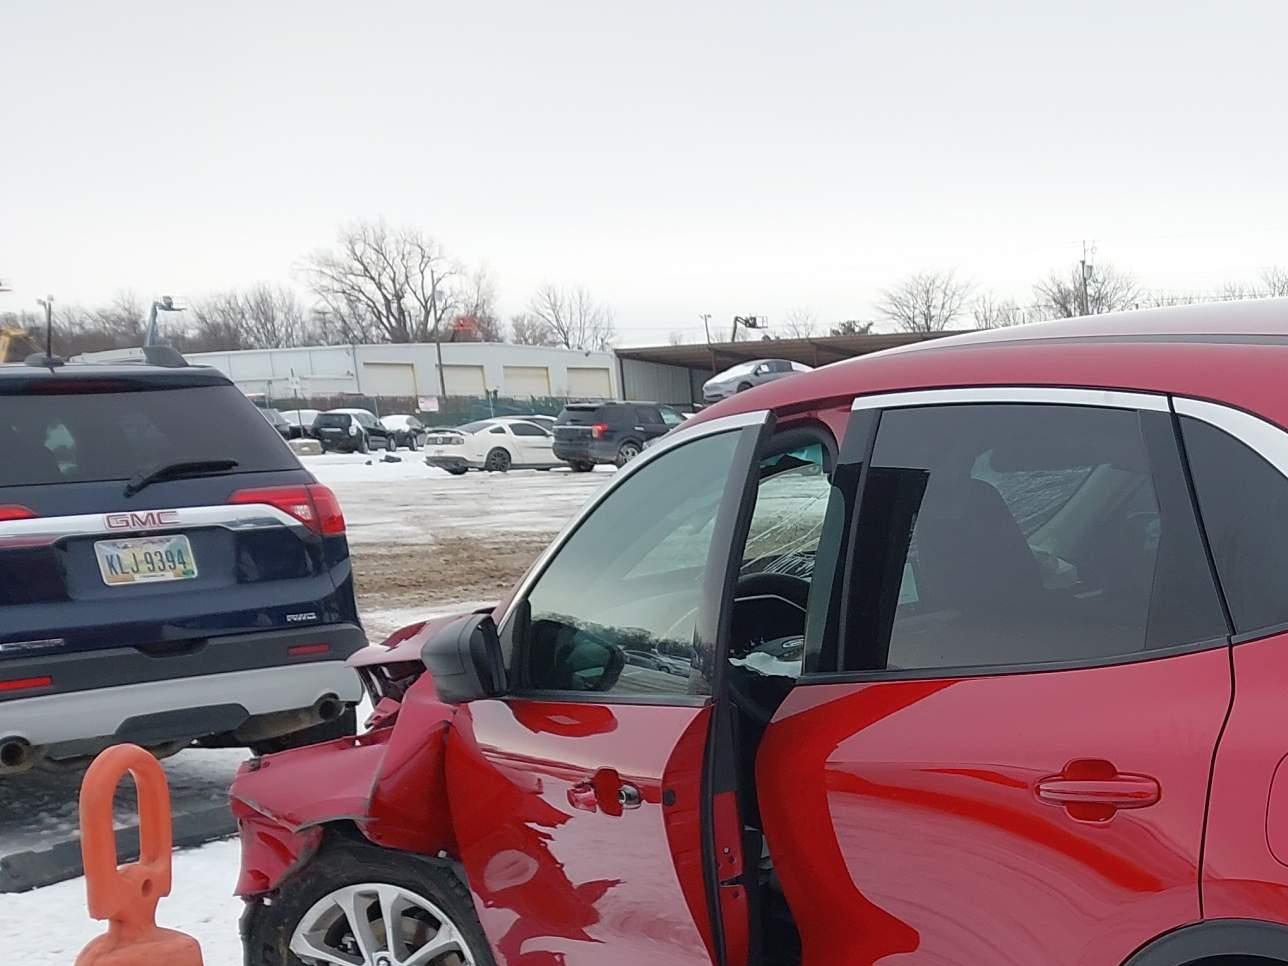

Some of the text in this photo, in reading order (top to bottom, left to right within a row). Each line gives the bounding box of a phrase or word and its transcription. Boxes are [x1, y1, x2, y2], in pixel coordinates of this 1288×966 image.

[105, 510, 181, 529] GMC
[105, 548, 188, 577] KLJ 9394
